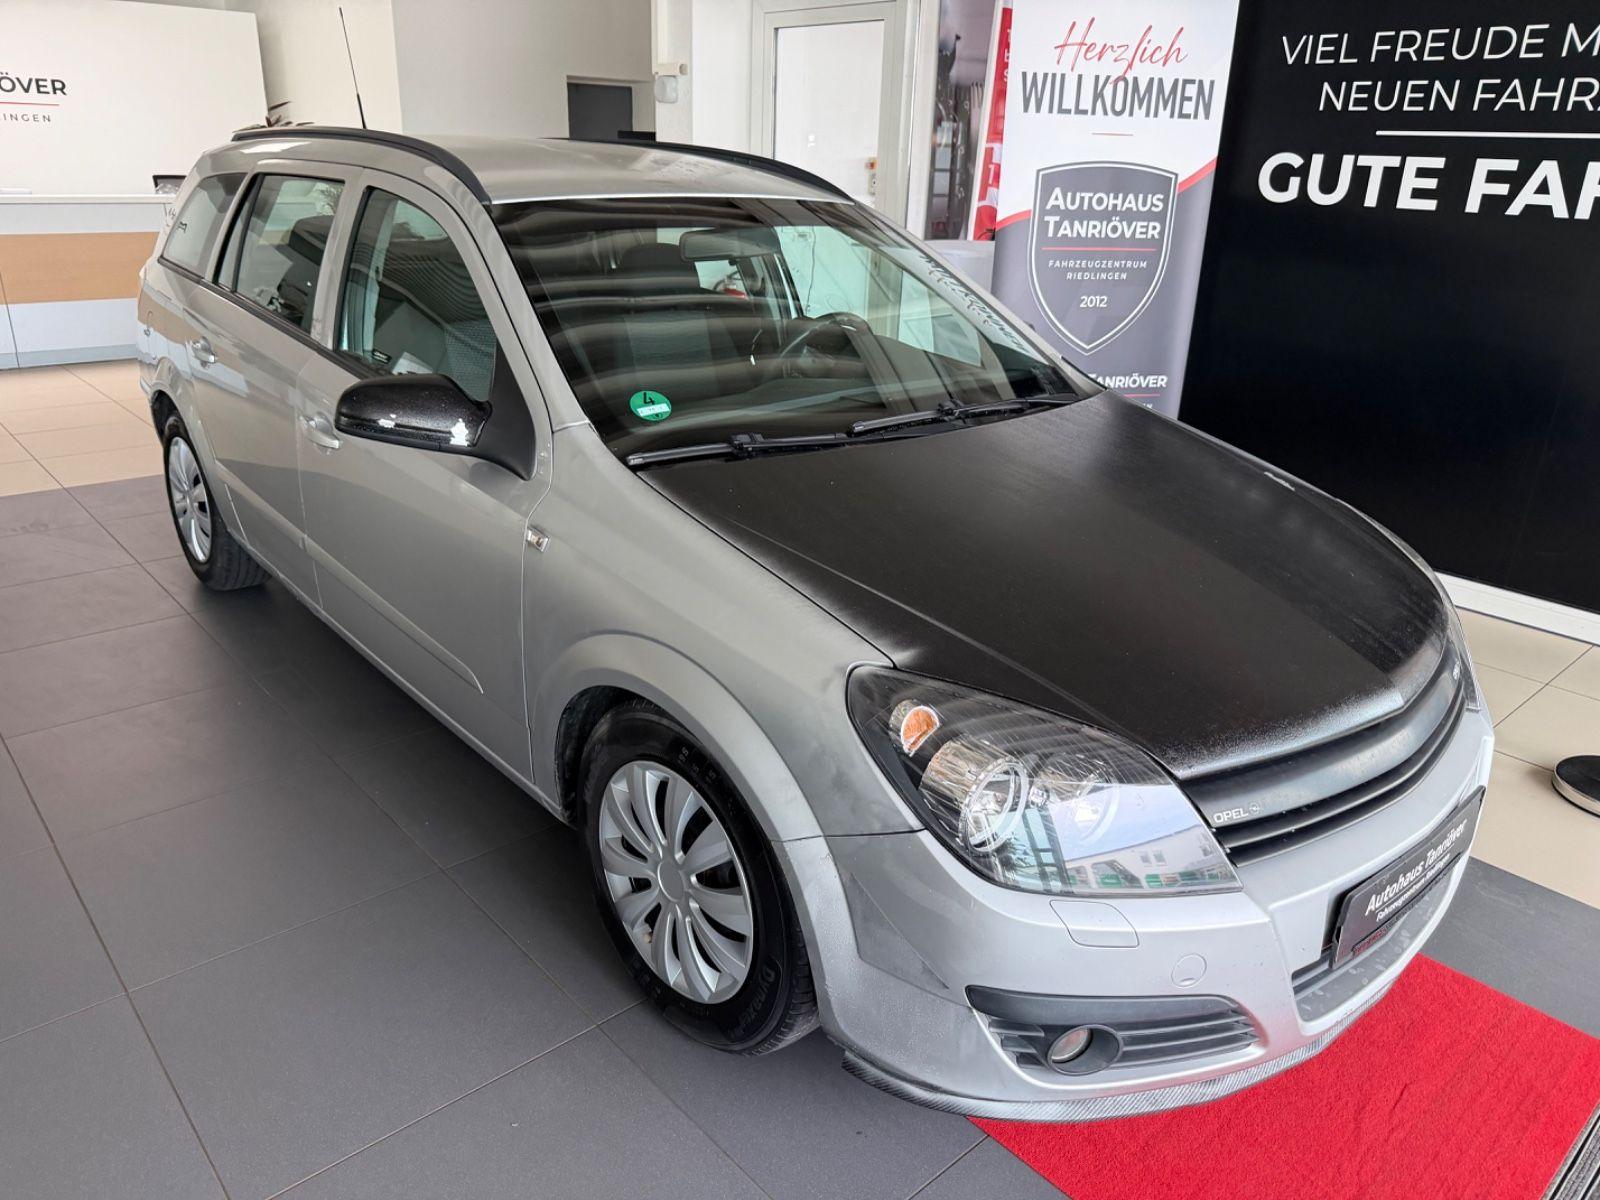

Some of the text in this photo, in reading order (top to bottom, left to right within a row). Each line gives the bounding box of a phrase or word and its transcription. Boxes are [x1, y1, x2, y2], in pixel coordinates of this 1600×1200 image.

[1054, 17, 1188, 85] Herzlich
[1282, 33, 1358, 65] VIEL
[1370, 24, 1550, 63] FREUDE
[0, 71, 67, 96] ÖVER
[1021, 71, 1215, 120] WILLKOMMEN
[1318, 77, 1600, 112] NEUEN FAHR
[0, 113, 51, 123] INGEN
[1258, 152, 1446, 211] GUTE
[1045, 186, 1164, 212] AUTOHAUS
[1043, 216, 1161, 239] TANRIÖVER
[1048, 260, 1147, 269] FAHRZEUGZENTRUM
[1066, 272, 1127, 281] RIEDLINGEN
[1079, 295, 1108, 308] 2012
[643, 392, 655, 405] 4
[1213, 808, 1249, 824] OPEL
[1365, 861, 1425, 917] Autohaus
